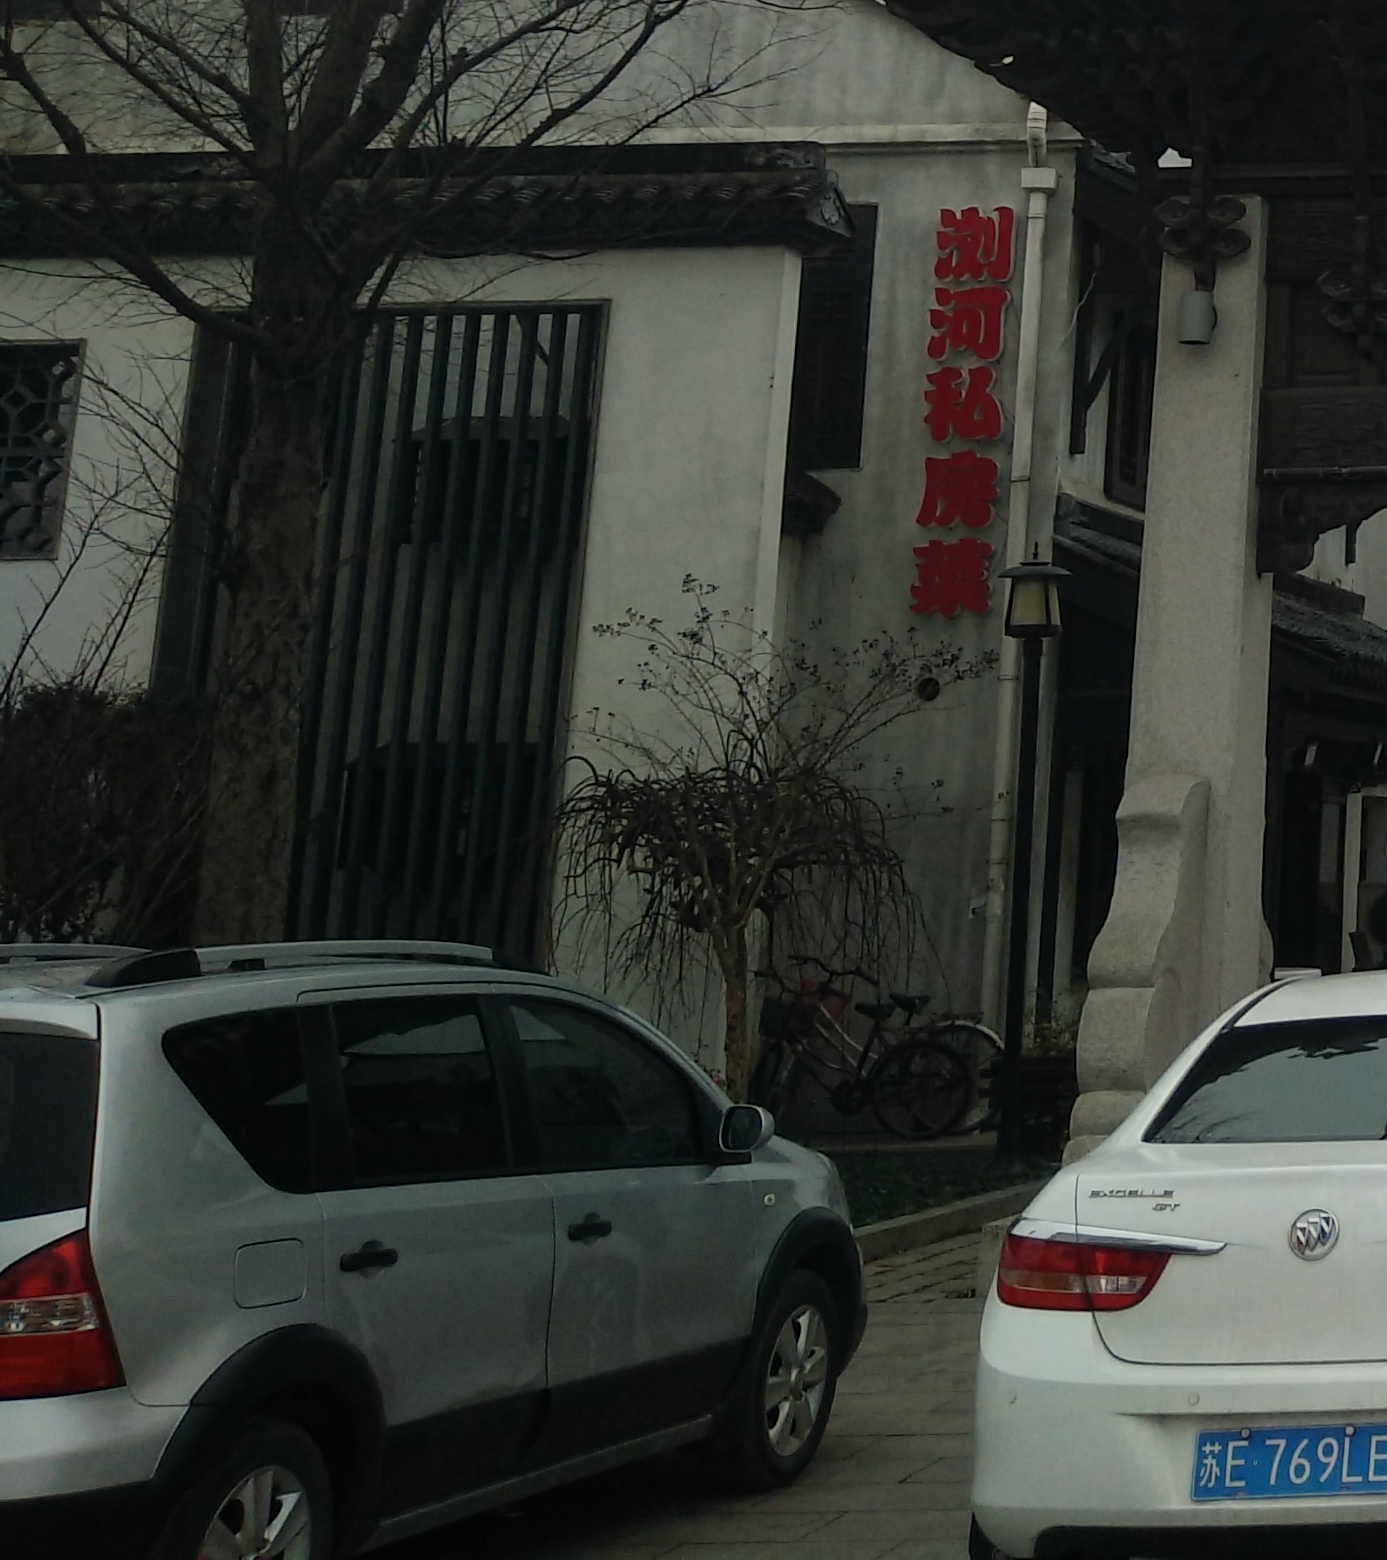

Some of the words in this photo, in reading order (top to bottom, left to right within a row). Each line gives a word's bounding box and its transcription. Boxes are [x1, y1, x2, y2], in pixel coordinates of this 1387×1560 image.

[909, 205, 1016, 617] 浏河私房菜
